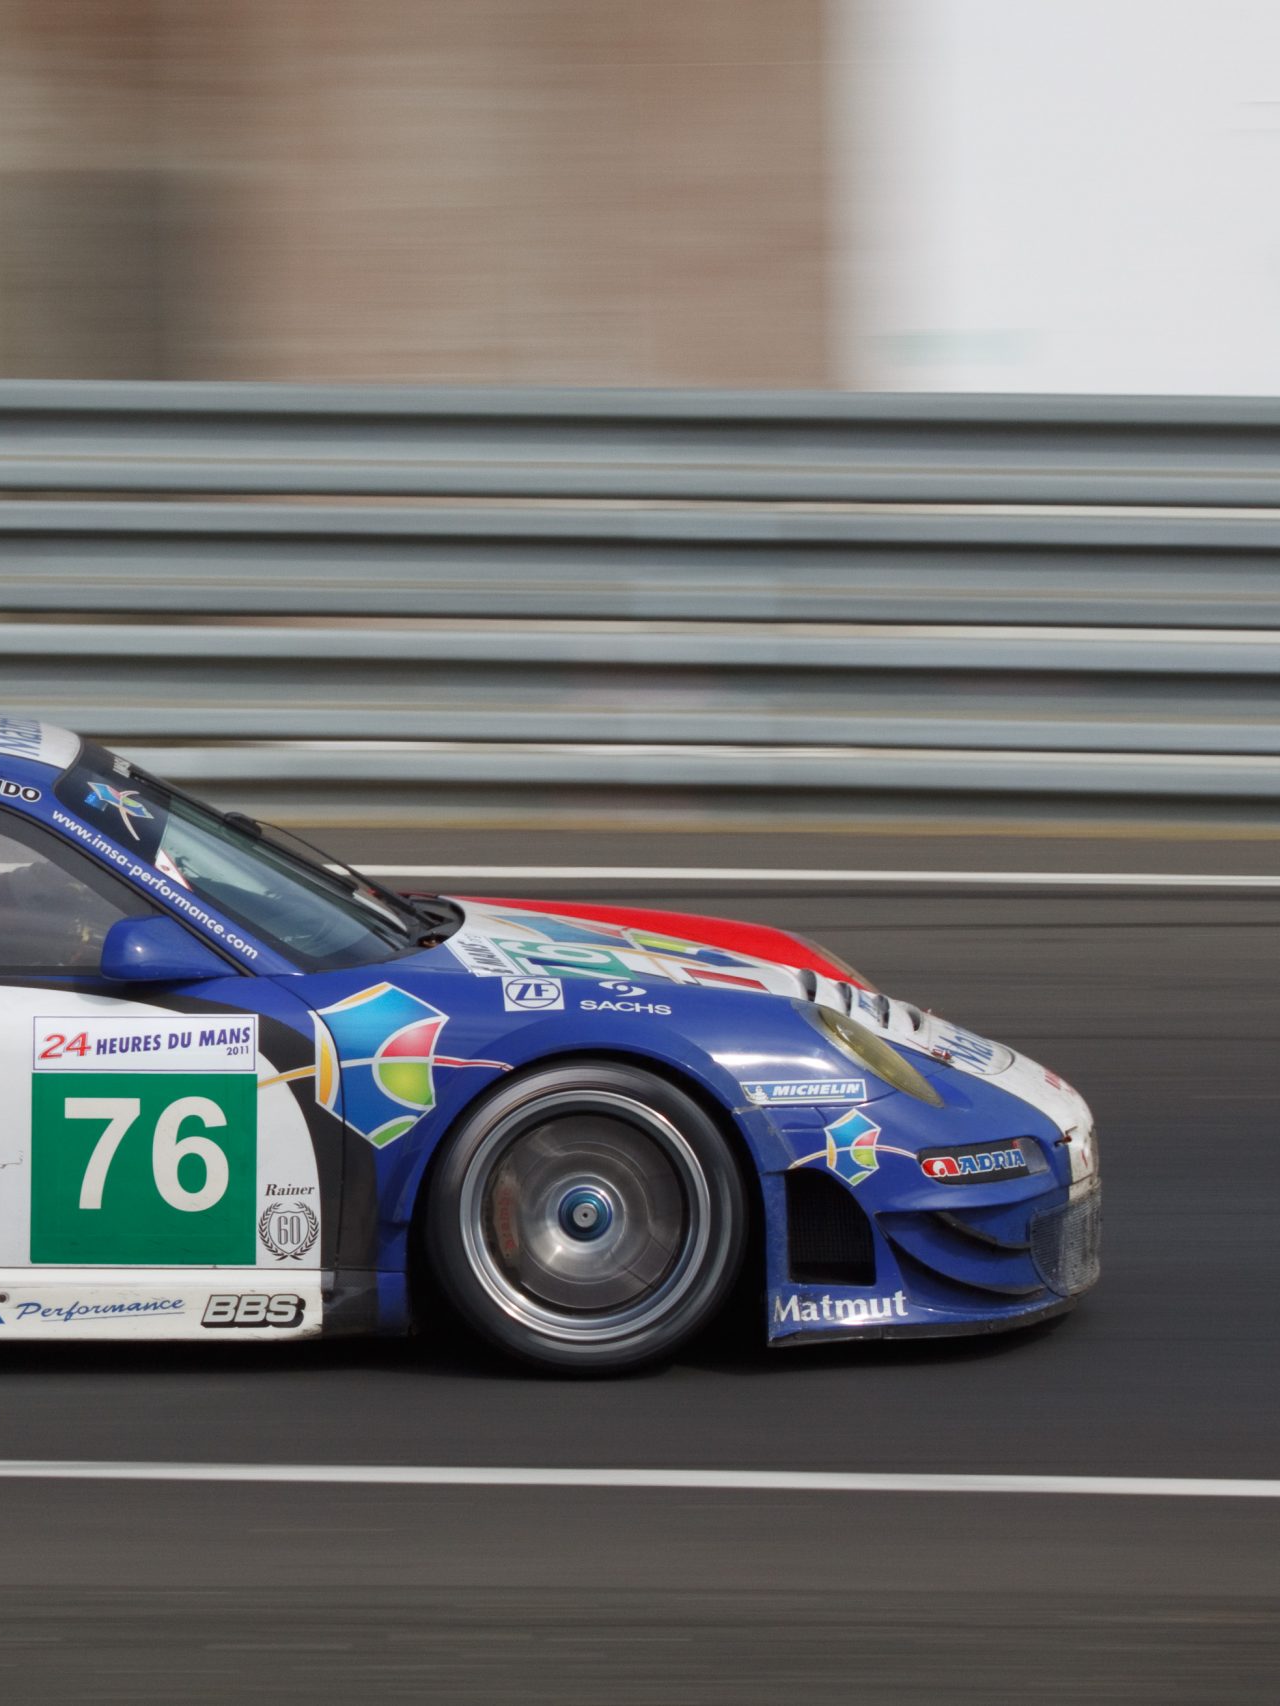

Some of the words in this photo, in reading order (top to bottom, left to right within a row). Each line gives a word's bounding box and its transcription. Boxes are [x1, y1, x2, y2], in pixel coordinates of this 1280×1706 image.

[52, 810, 259, 960] www.imsa-performance.com
[580, 1000, 672, 1016] SACHS
[38, 1032, 92, 1060] 24
[96, 1034, 162, 1056] HEURES
[168, 1032, 192, 1049] DU
[198, 1027, 251, 1047] MANS
[226, 1045, 250, 1056] 2011
[772, 1083, 861, 1097] MICHELIN
[64, 1096, 230, 1213] 76
[958, 1149, 1026, 1175] ADRIA
[265, 1183, 316, 1197] Rainer
[277, 1215, 301, 1246] 60
[16, 1297, 185, 1322] Performance
[200, 1293, 306, 1329] BBS
[773, 1290, 909, 1323] Matmut
